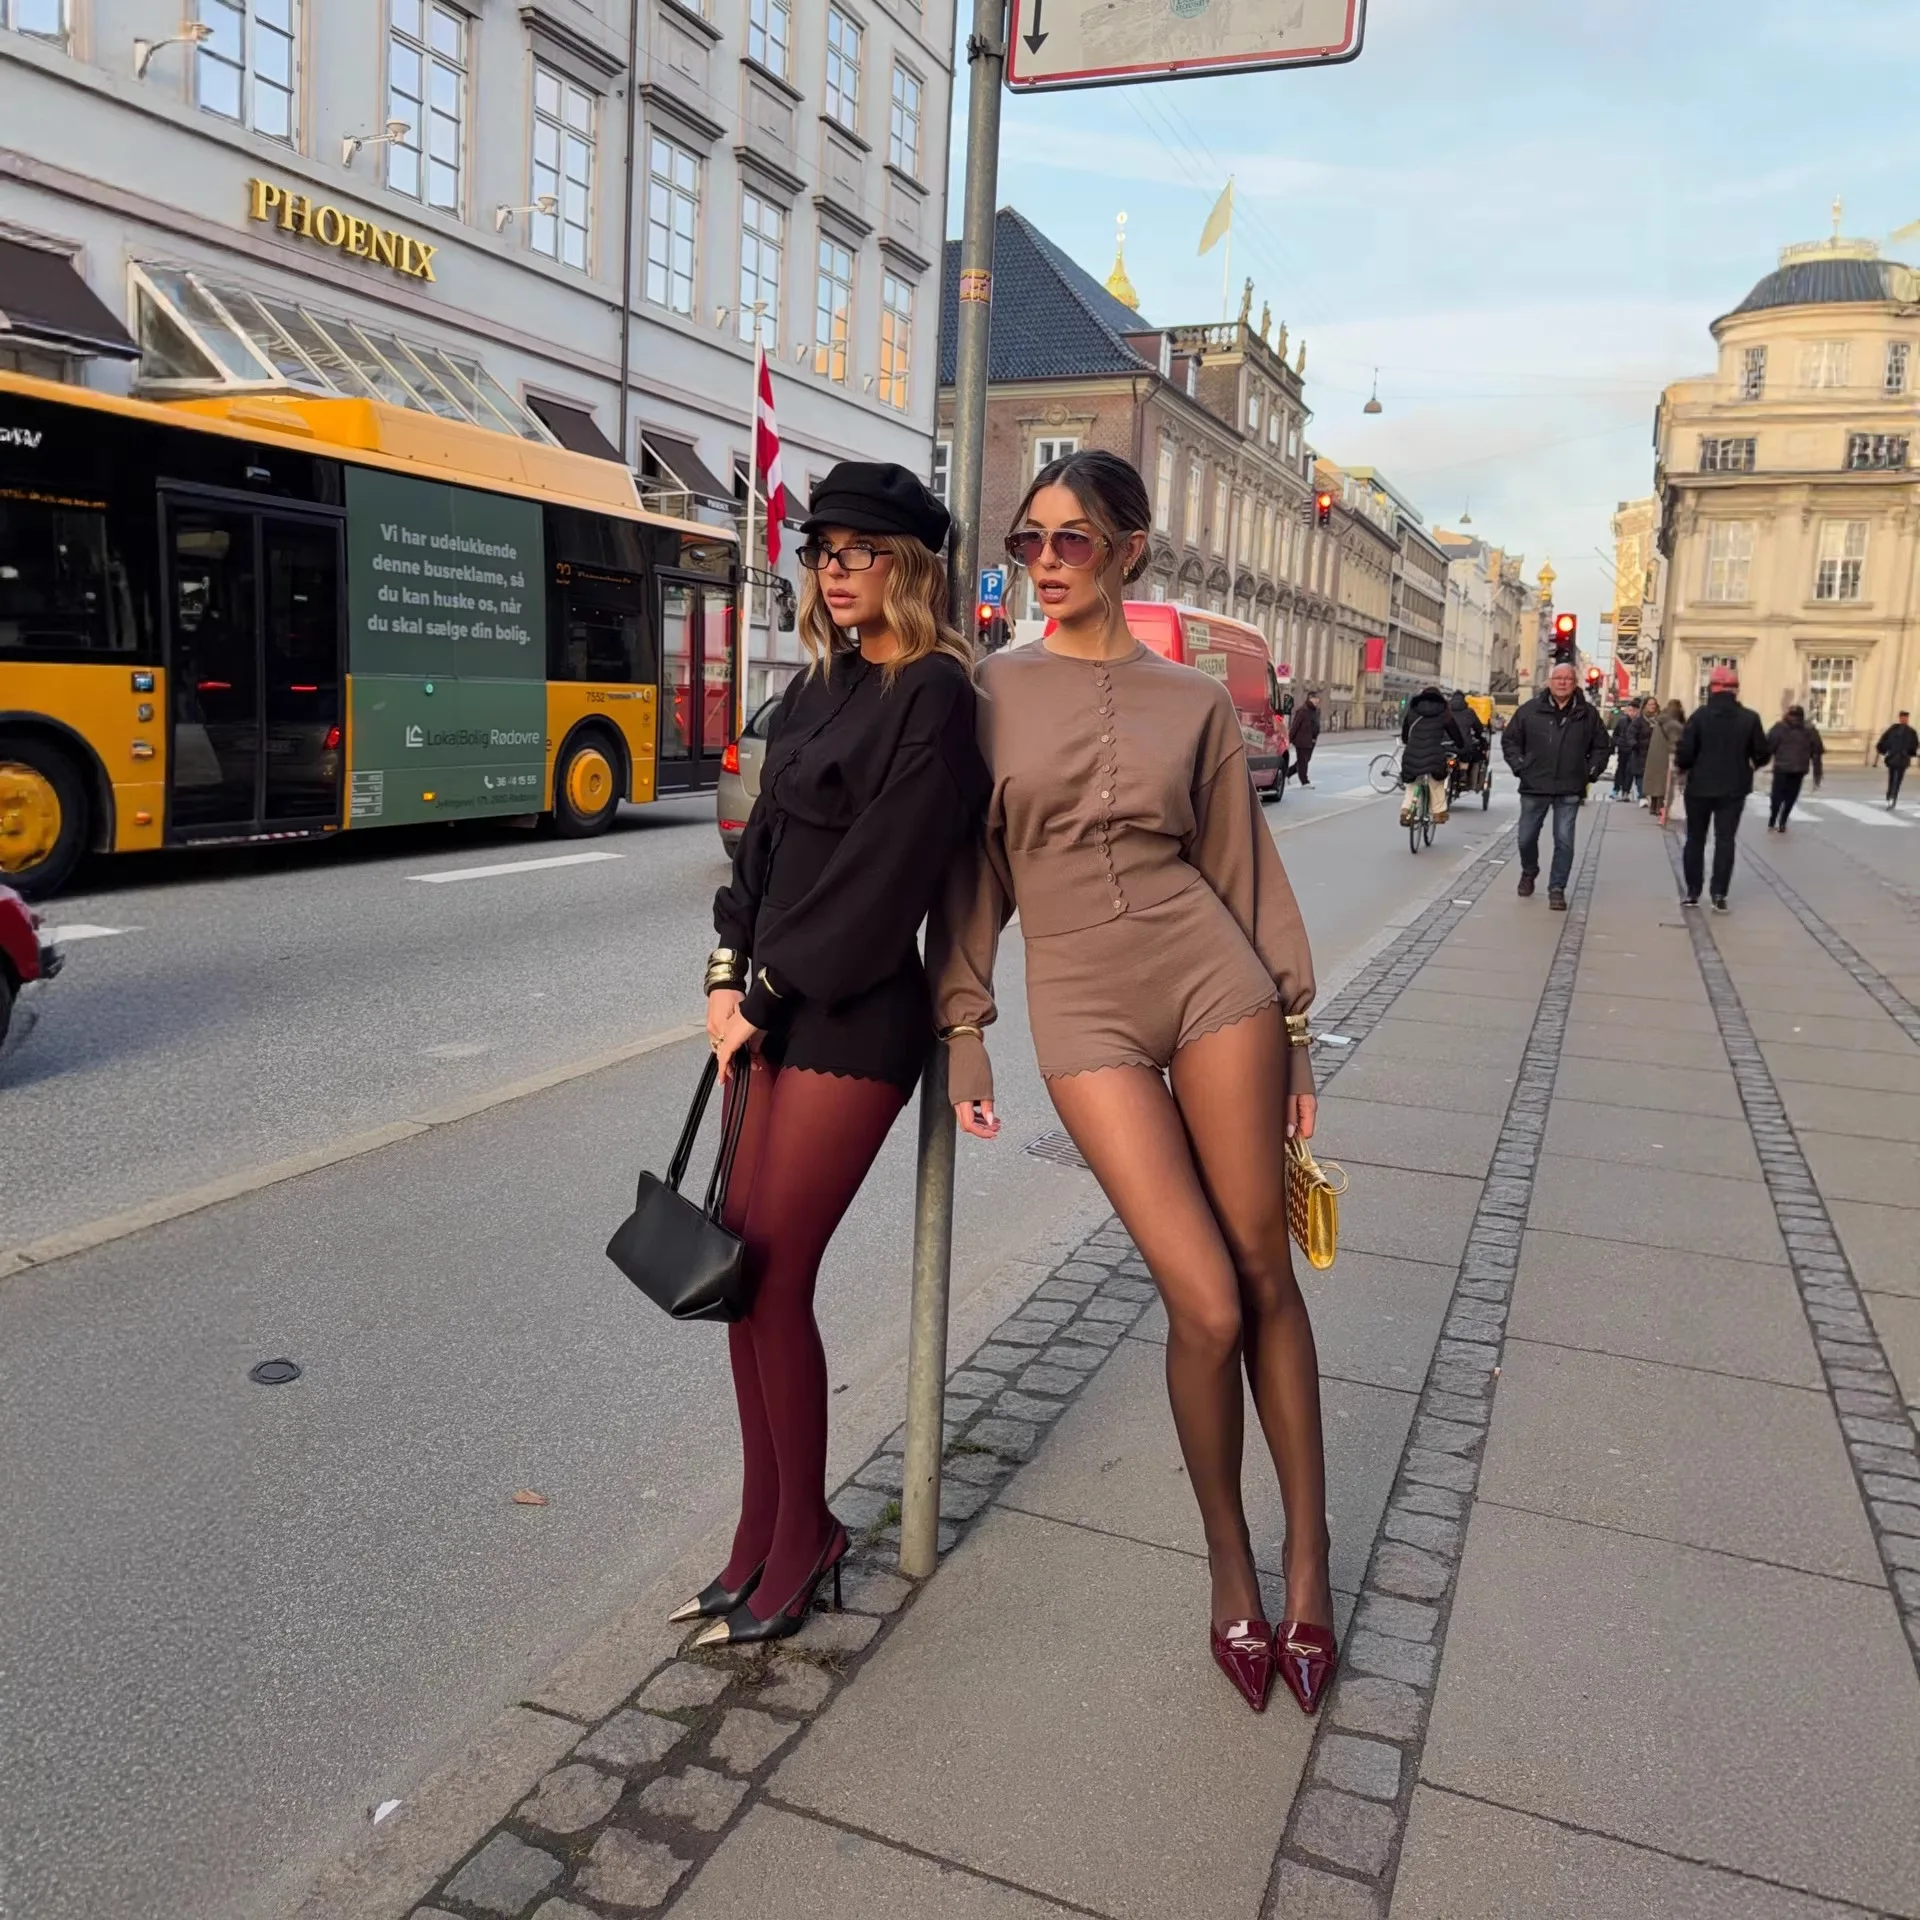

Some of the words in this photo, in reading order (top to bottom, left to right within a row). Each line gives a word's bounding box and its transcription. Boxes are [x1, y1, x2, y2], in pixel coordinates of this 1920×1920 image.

[248, 177, 439, 283] PHOENIX
[380, 523, 398, 542] Vi
[402, 527, 427, 546] har
[430, 534, 517, 559] udelukkende
[372, 554, 420, 575] denne
[424, 560, 508, 588] busreklame,
[510, 571, 525, 588] så
[987, 577, 998, 592] P
[378, 585, 398, 601] du
[402, 587, 430, 605] kan
[433, 590, 475, 609] huske
[478, 598, 497, 614] os,
[500, 597, 522, 614] når
[367, 614, 388, 631] du
[392, 617, 422, 634] skal
[426, 620, 468, 640] sælge
[471, 622, 492, 639] din
[495, 624, 531, 645] bolig.
[586, 692, 605, 703] 7552
